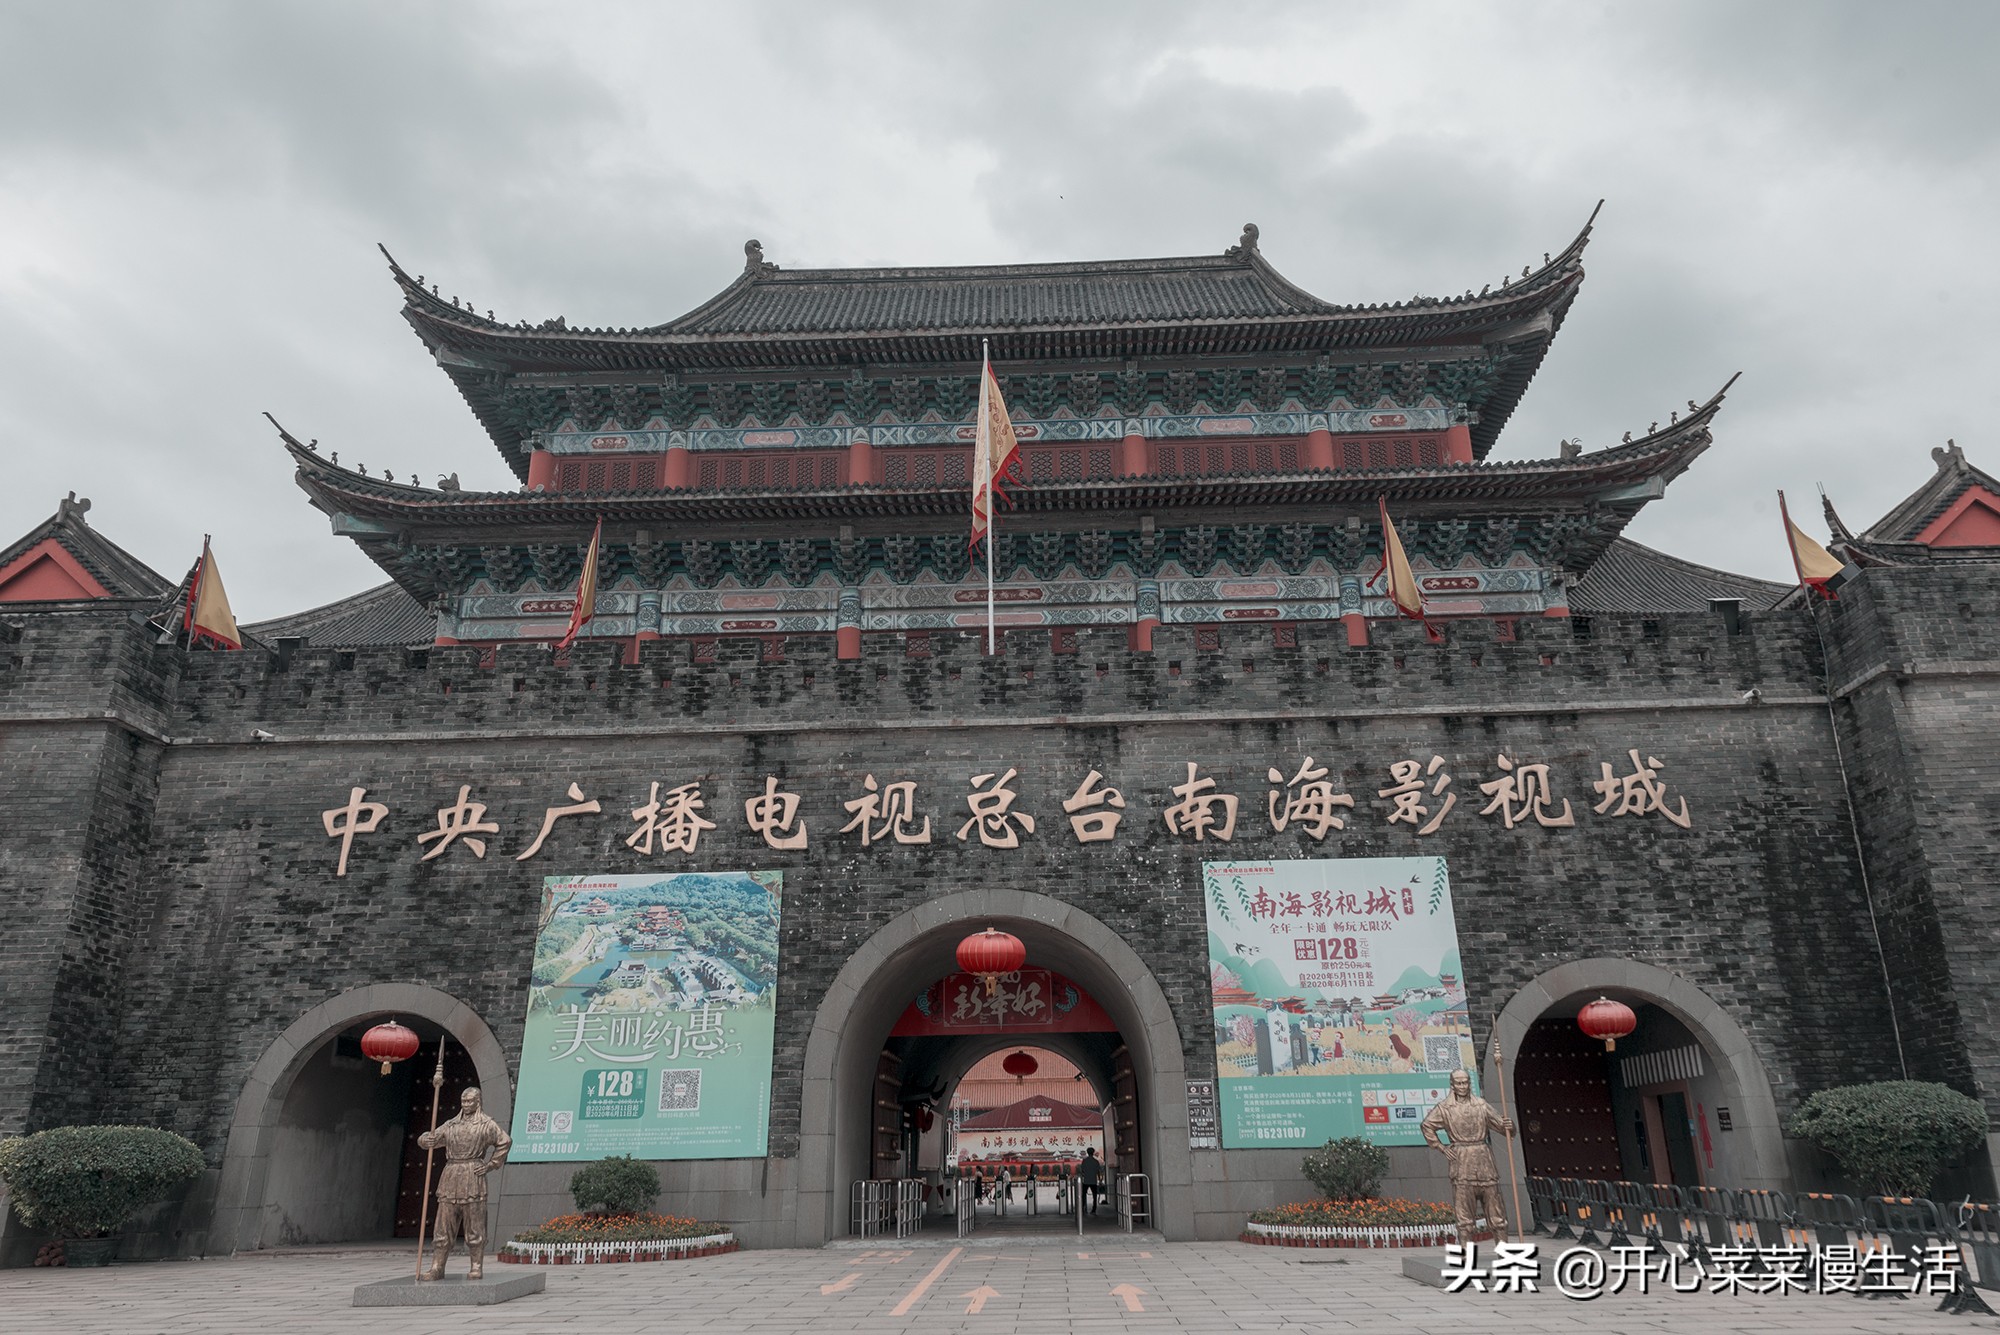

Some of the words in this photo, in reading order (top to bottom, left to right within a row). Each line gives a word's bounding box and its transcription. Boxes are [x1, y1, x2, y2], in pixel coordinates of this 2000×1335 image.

[323, 749, 1691, 876] 中央广播电视总台南海影视城
[1250, 886, 1399, 921] 南海影视城
[1269, 922, 1327, 934] 全年一卡通
[1333, 920, 1392, 933] 畅玩无限次
[1295, 940, 1315, 950] 限时
[1317, 937, 1359, 960] 128
[1299, 971, 1374, 981] 自2020年5月11日起
[1300, 980, 1375, 989] 至2020年6月11日止
[952, 981, 1047, 1031] 新年好
[1257, 1126, 1306, 1139] 85231007
